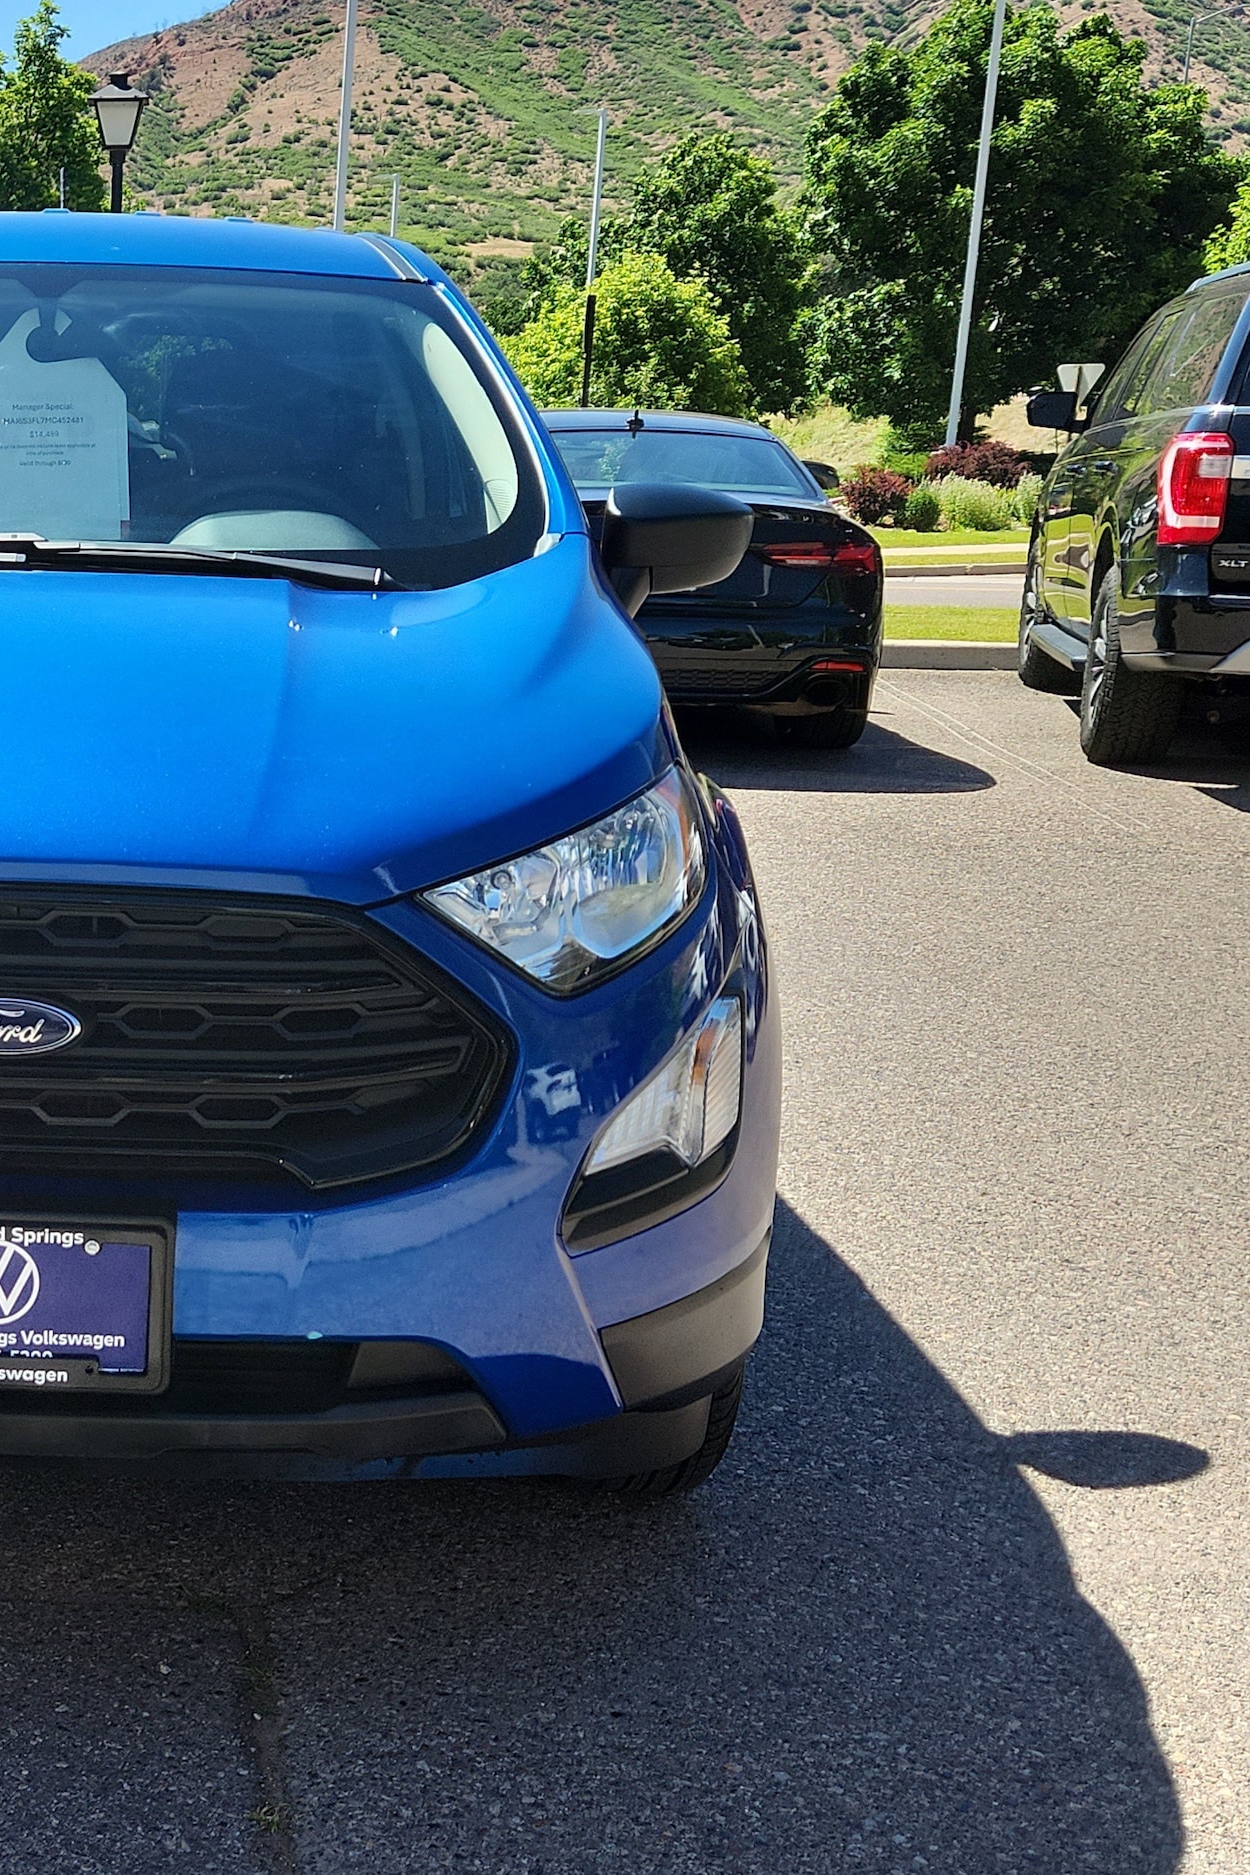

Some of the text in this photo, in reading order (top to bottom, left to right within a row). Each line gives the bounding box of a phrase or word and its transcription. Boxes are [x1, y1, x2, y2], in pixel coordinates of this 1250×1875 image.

[12, 403, 44, 411] Manager
[1218, 559, 1249, 568] XLT
[10, 1226, 85, 1248] Springs
[20, 1330, 125, 1349] Volkswagen
